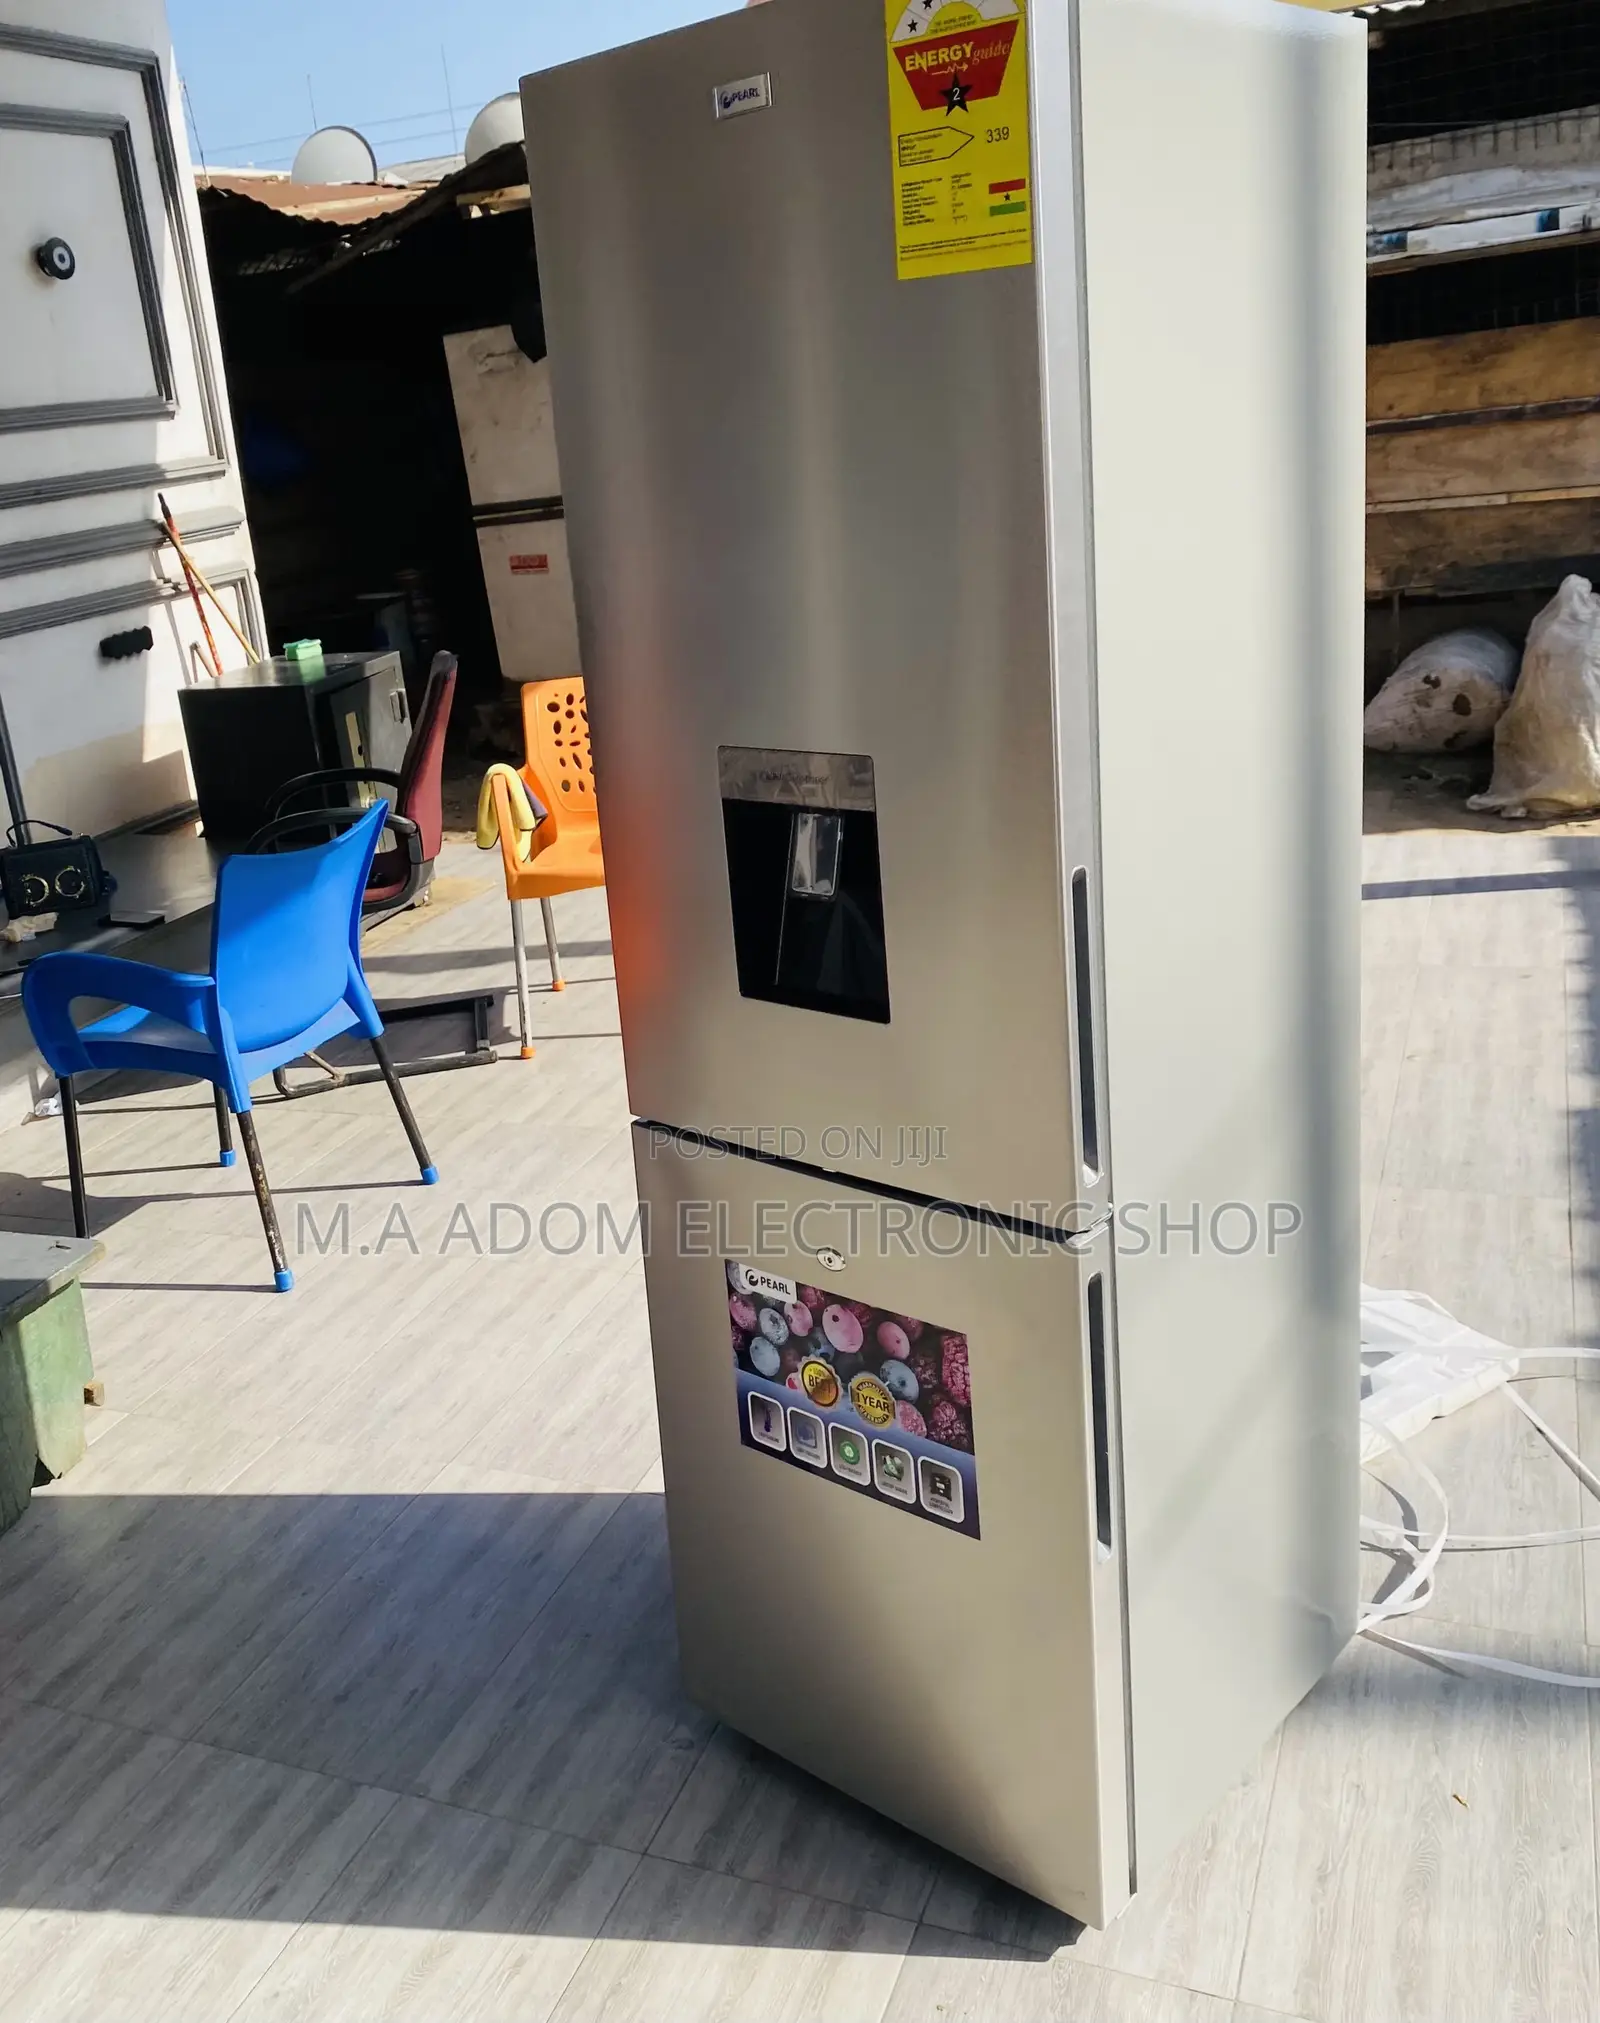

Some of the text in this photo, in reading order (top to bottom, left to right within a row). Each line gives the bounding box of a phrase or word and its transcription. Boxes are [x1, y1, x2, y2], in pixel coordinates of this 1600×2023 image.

[905, 40, 1010, 72] ENERGY guide
[731, 87, 761, 102] PEARL
[952, 87, 961, 101] 2
[985, 126, 1010, 144] 339
[760, 1276, 791, 1295] PEARL
[862, 1394, 890, 1414] YEAR
